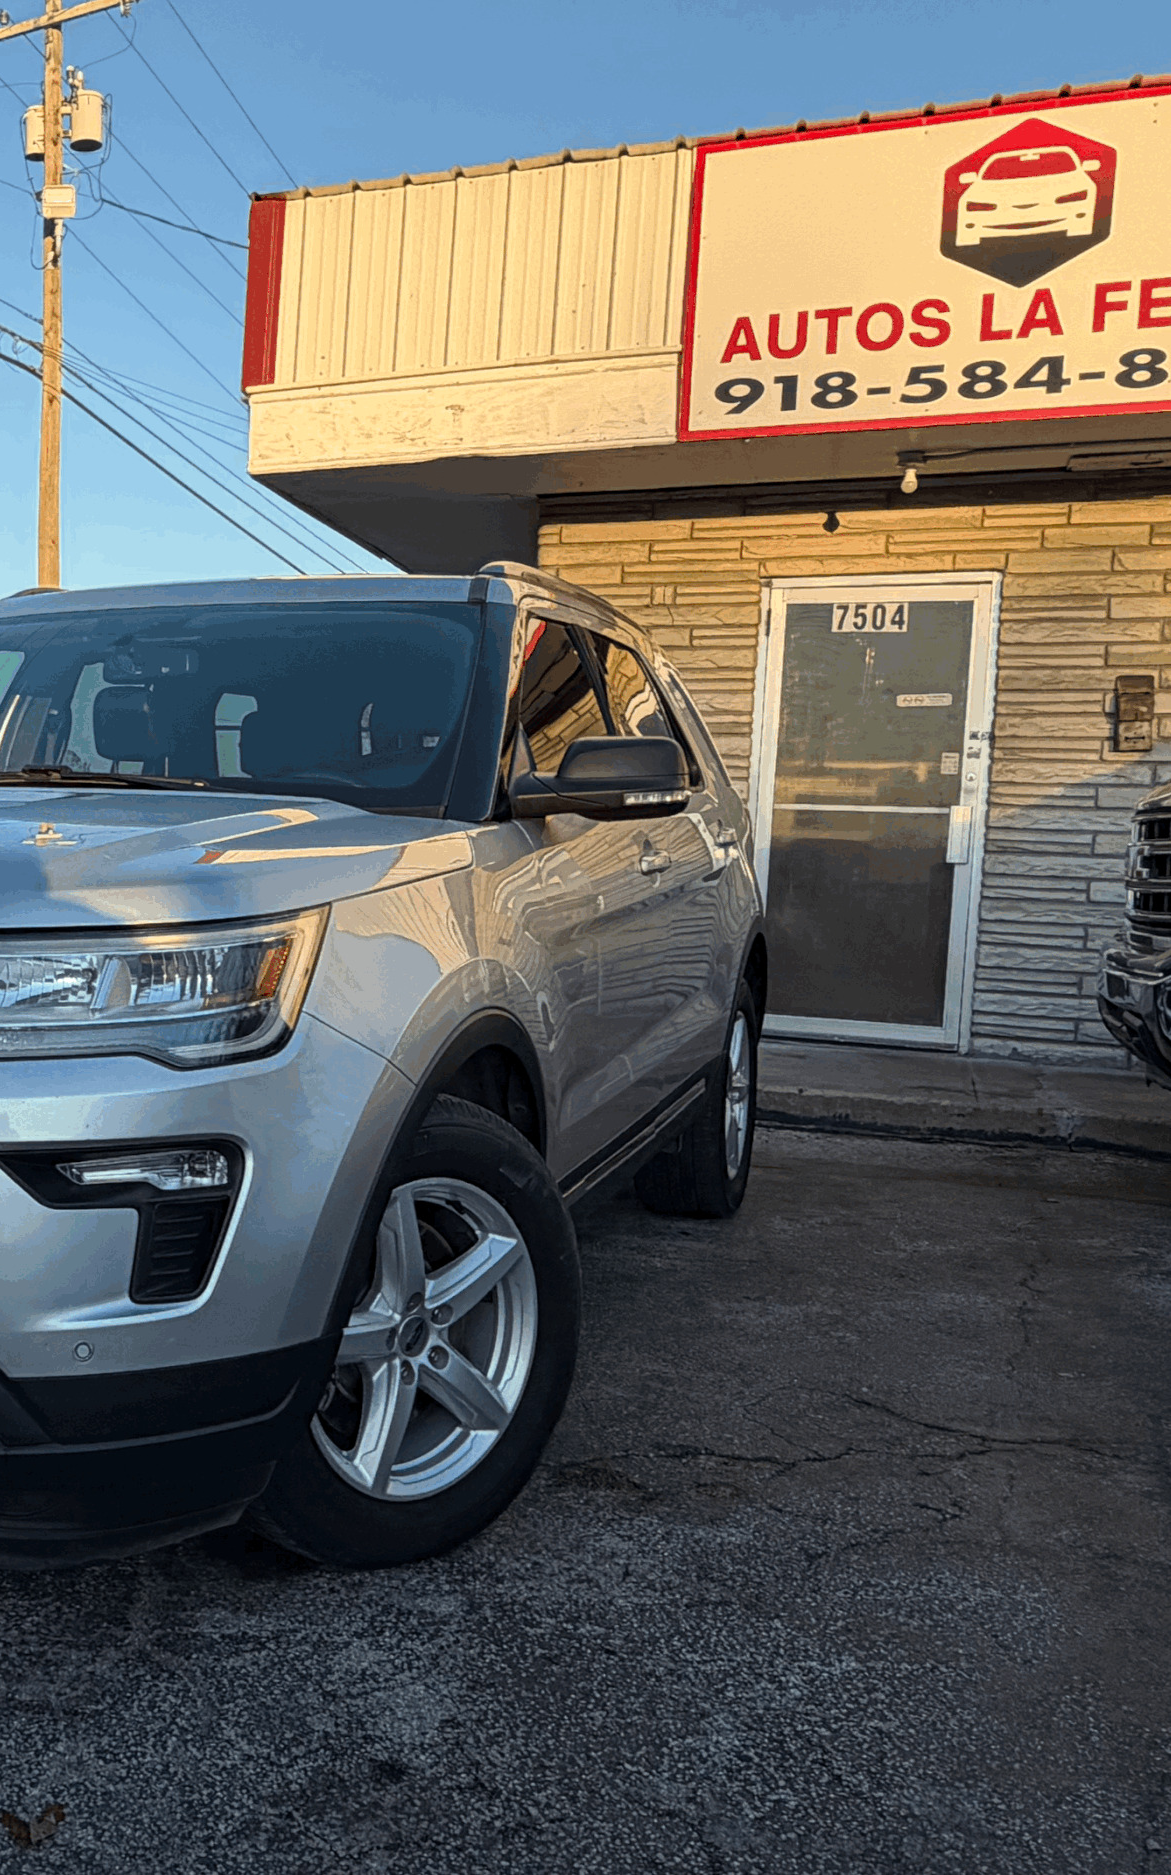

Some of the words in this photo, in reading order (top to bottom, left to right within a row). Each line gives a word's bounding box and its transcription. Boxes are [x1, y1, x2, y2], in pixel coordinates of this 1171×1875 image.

[720, 298, 951, 364] AUTOS
[979, 288, 1064, 342] LA
[1092, 277, 1171, 333] FE
[714, 348, 1168, 415] 918-584-8
[836, 604, 905, 630] 7504
